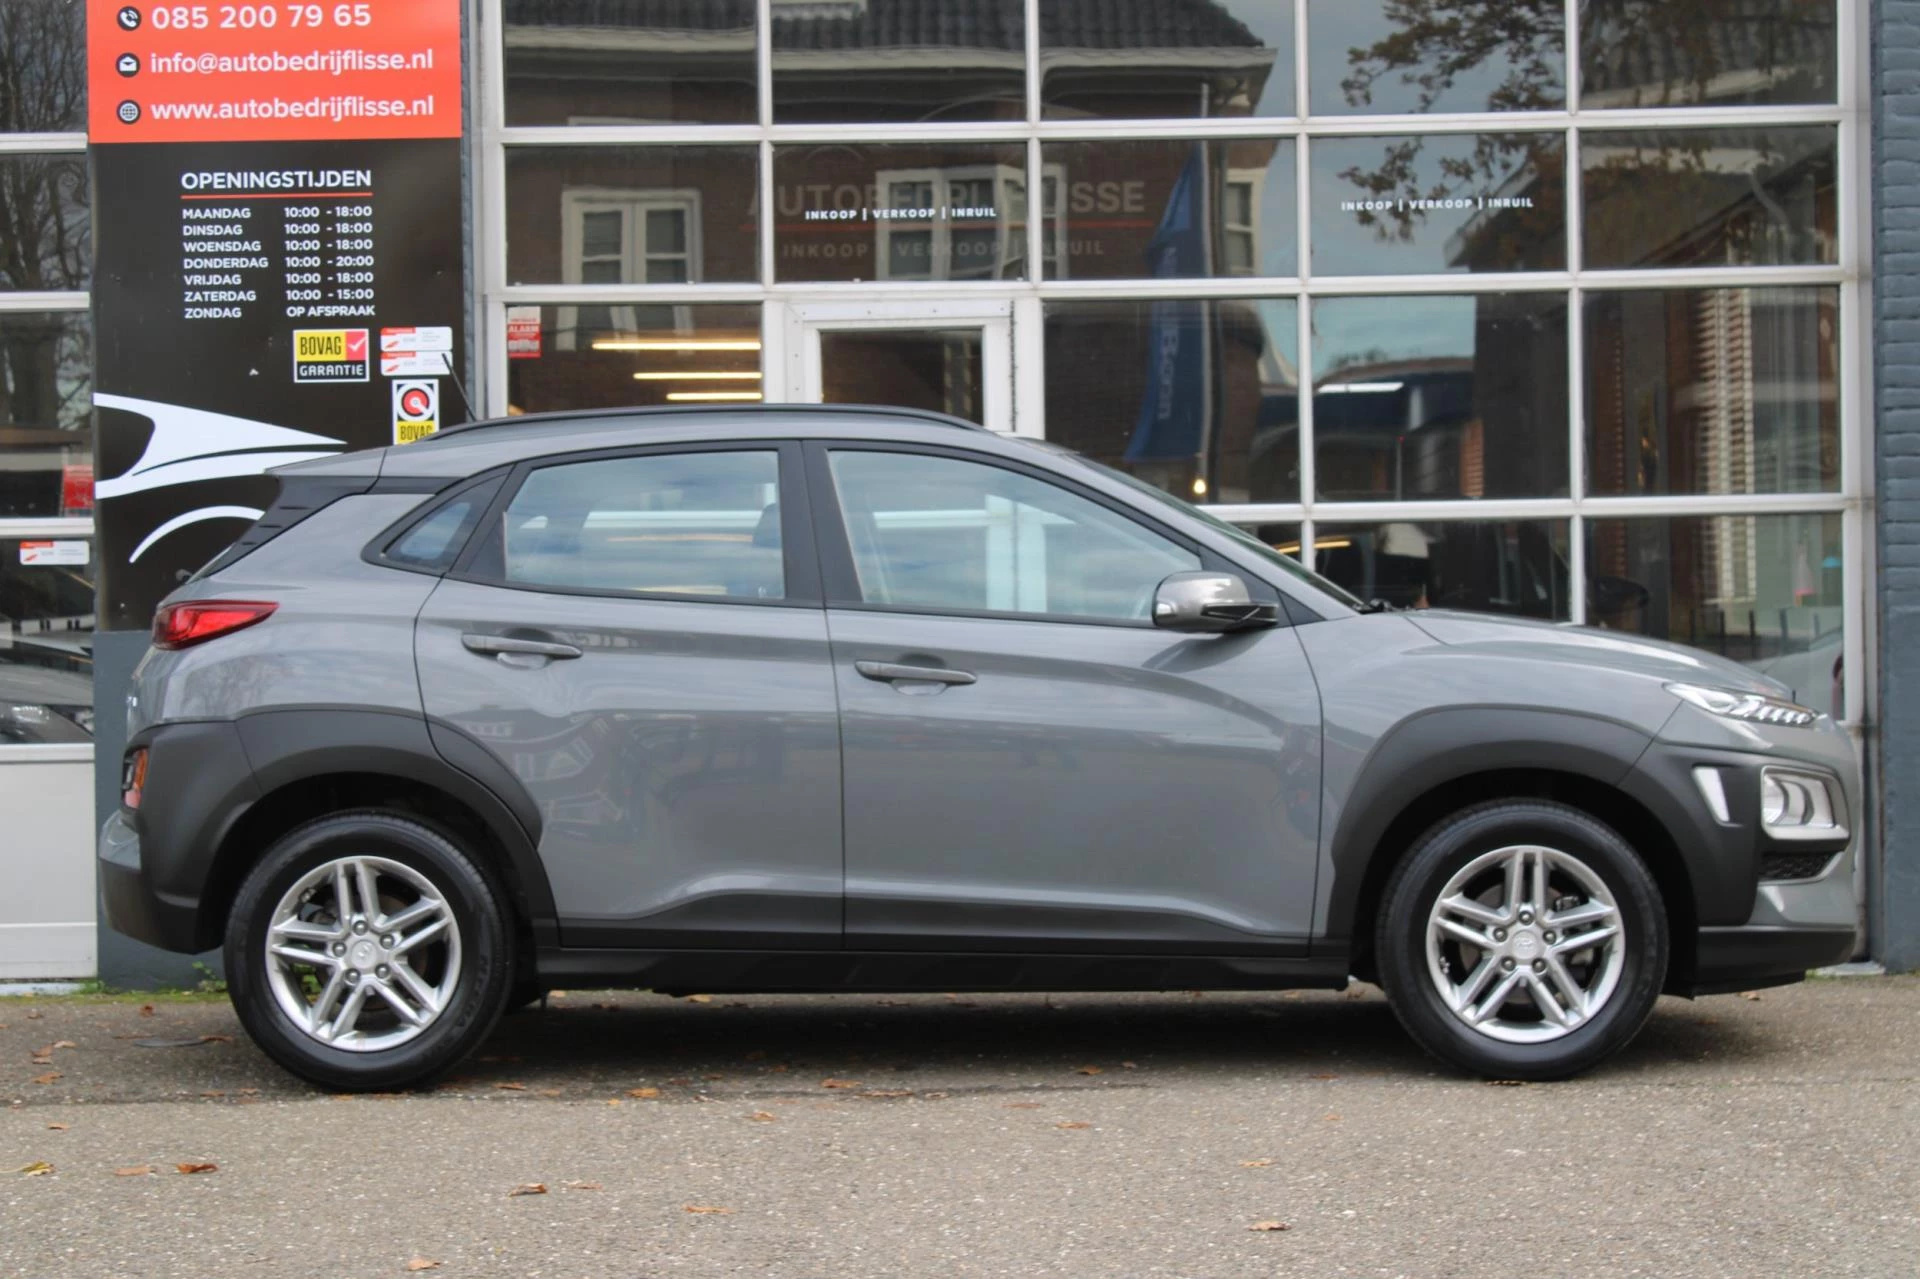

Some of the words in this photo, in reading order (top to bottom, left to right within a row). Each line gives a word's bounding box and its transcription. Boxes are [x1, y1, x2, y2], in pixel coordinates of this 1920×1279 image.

[151, 6, 209, 29] 085
[219, 5, 277, 28] 200
[287, 4, 323, 27] 79
[333, 3, 371, 26] 65
[150, 48, 433, 76] info@autobedrijflisse.nl
[150, 94, 434, 123] www.autobedrijflisse.nl
[180, 169, 372, 190] OPENINGSTIJDEN
[1341, 201, 1394, 211] INKOOP
[1408, 199, 1474, 210] VERKOOP
[1488, 197, 1534, 208] INRUIL
[182, 208, 252, 220] MAANDAG
[284, 206, 320, 218] 10:00
[334, 205, 373, 217] 18:00
[805, 209, 857, 220] INKOOP
[872, 208, 937, 219] VERKOOP
[951, 207, 997, 217] INRUIL
[182, 224, 244, 237] DINSDAG
[284, 222, 321, 234] 10:00
[335, 222, 373, 234] 18:00
[182, 240, 262, 253] WOENSDAG
[284, 239, 321, 251] 10:00
[335, 238, 373, 250] 18:00
[183, 256, 269, 269] DONDERDAG
[285, 256, 321, 267] 10:00
[335, 254, 375, 267] 20:00
[183, 273, 242, 286] VRIJDAG
[285, 272, 322, 284] 10:00
[336, 271, 374, 283] 18:00
[183, 290, 257, 303] ZATERDAG
[285, 289, 322, 301] 10:00
[336, 288, 375, 300] 15:00
[184, 306, 242, 319] ZONDAG
[286, 305, 306, 318] OP
[307, 304, 376, 317] AFSPRAAK
[300, 336, 342, 356] BOVAG
[299, 363, 364, 377] GARANTIE
